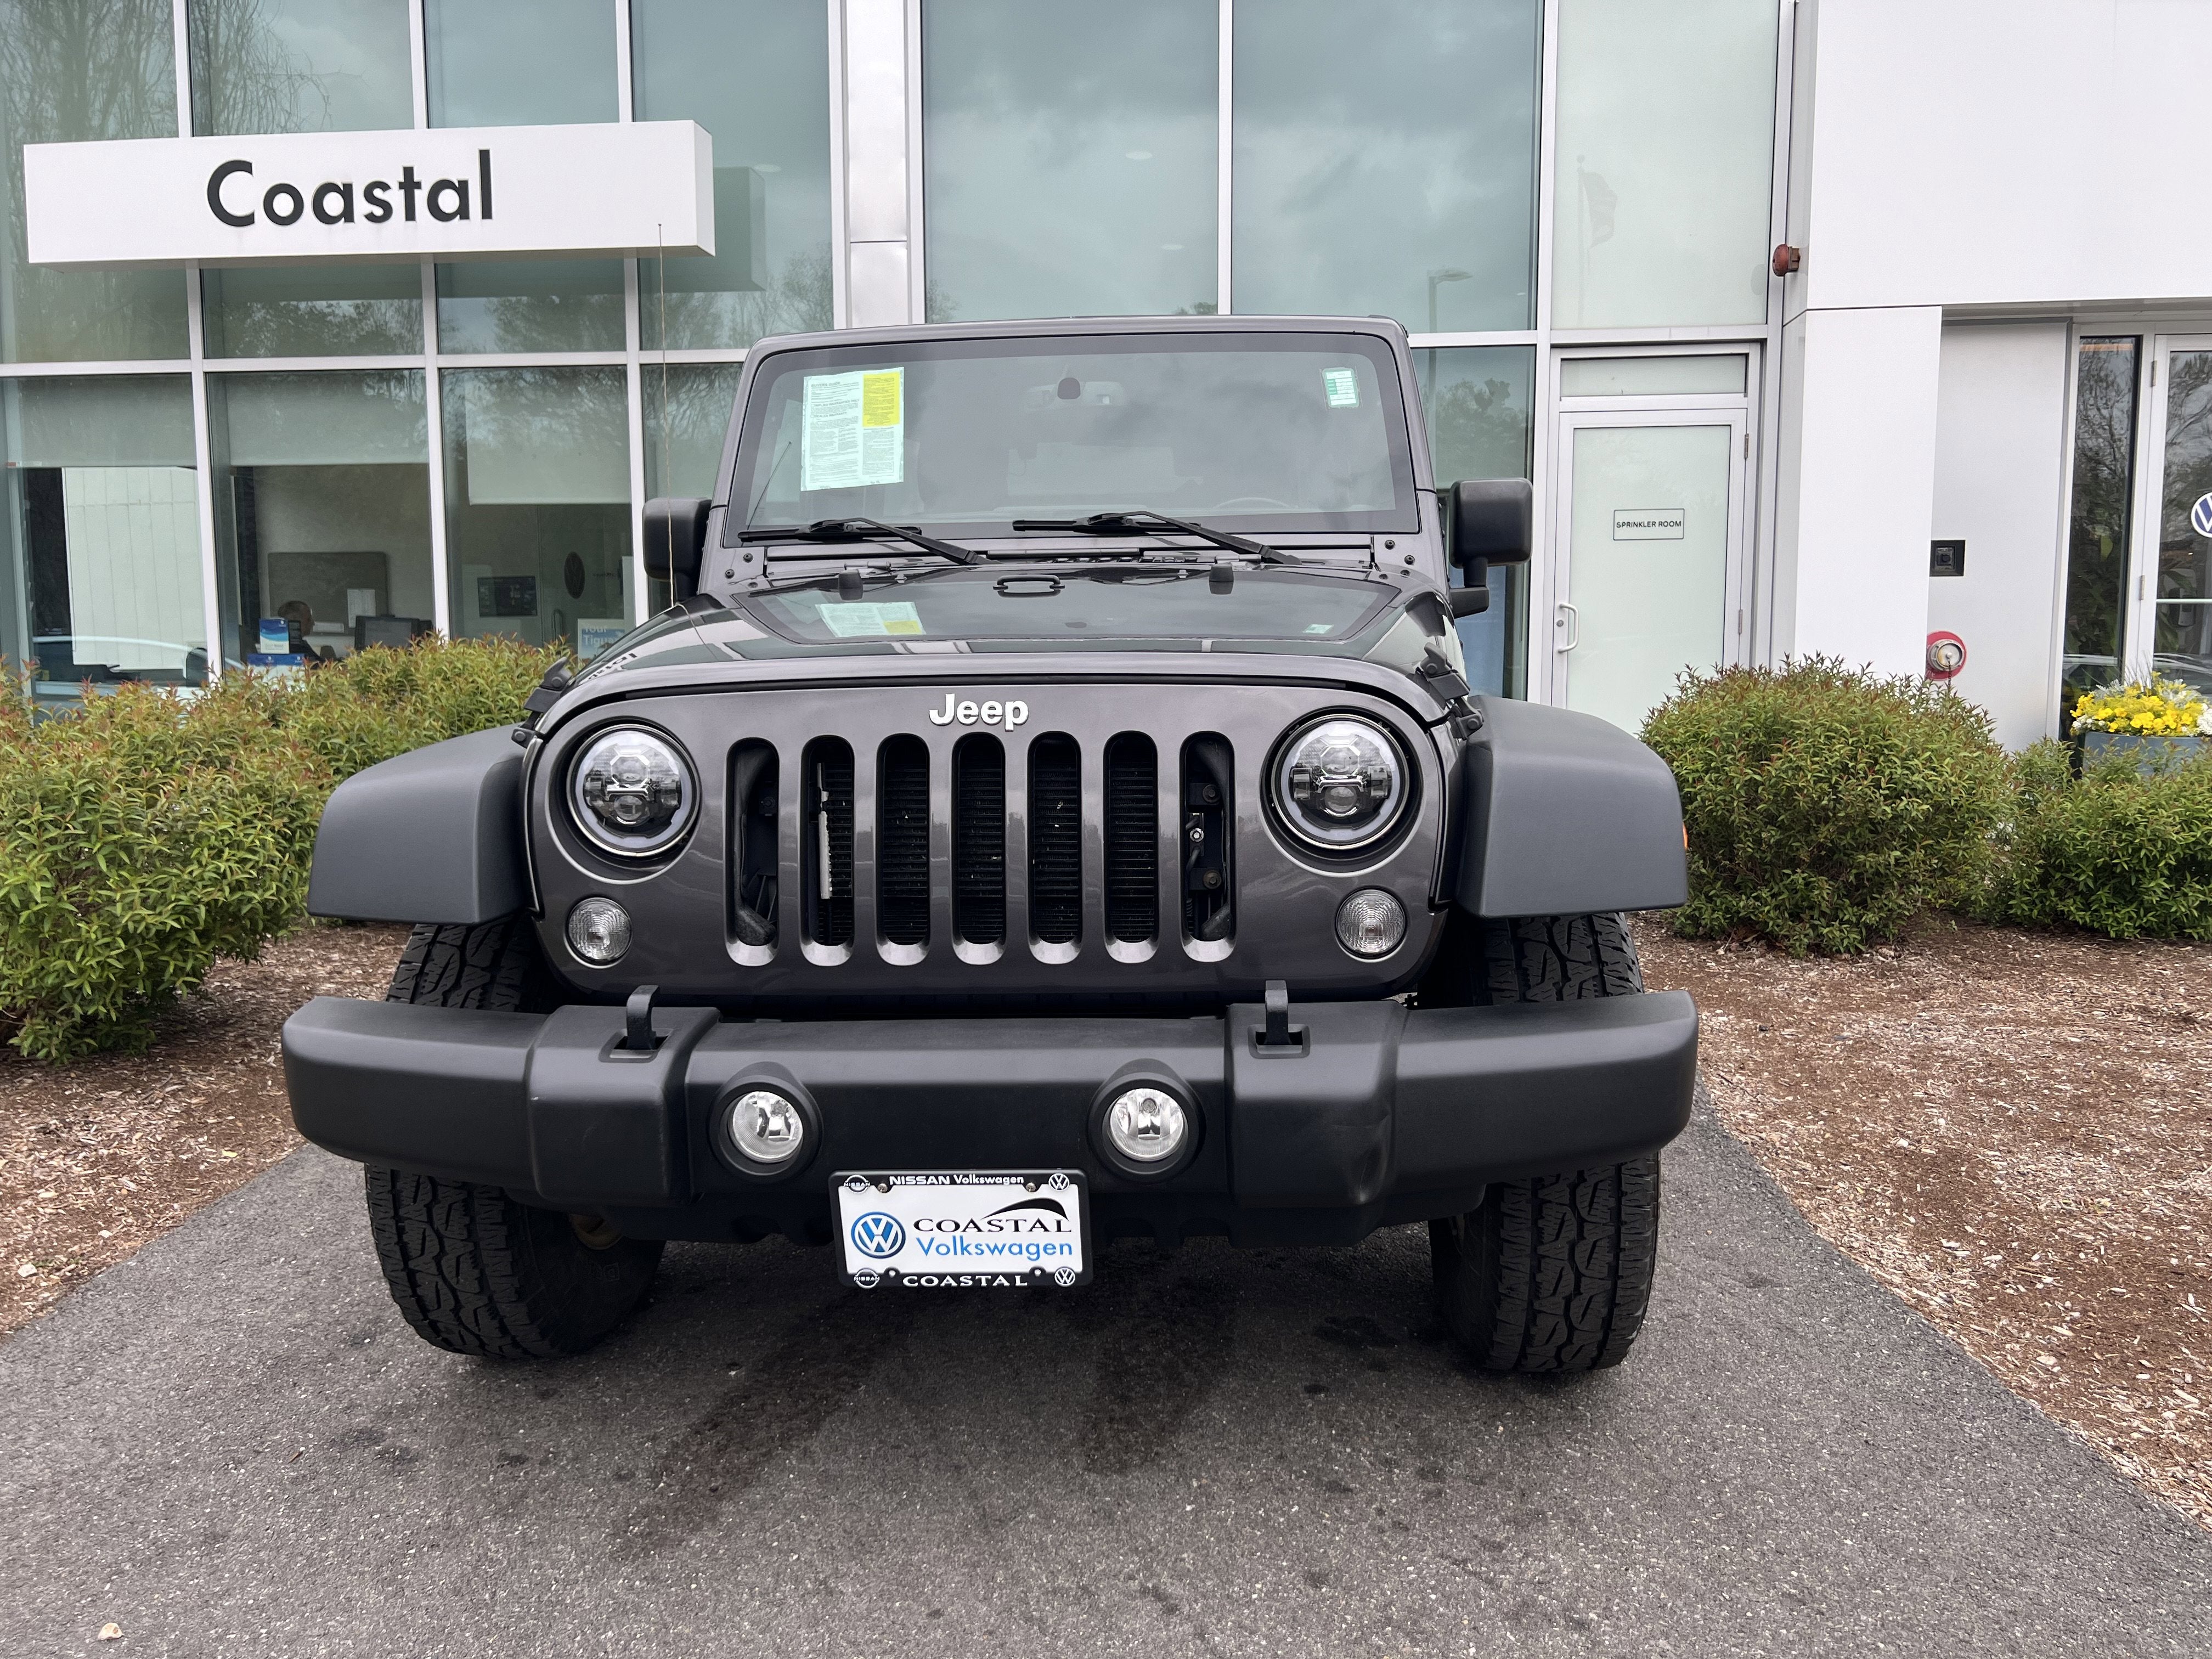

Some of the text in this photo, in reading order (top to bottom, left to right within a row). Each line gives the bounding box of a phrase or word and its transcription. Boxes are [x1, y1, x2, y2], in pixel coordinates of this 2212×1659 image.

[207, 148, 493, 227] Coastal
[929, 693, 1029, 732] Jeep
[889, 1174, 1024, 1186] NISSAN Volkswagen
[913, 1218, 1072, 1233] COASTAL
[916, 1235, 1073, 1261] Volkswagen
[902, 1275, 1028, 1287] COASTAL
